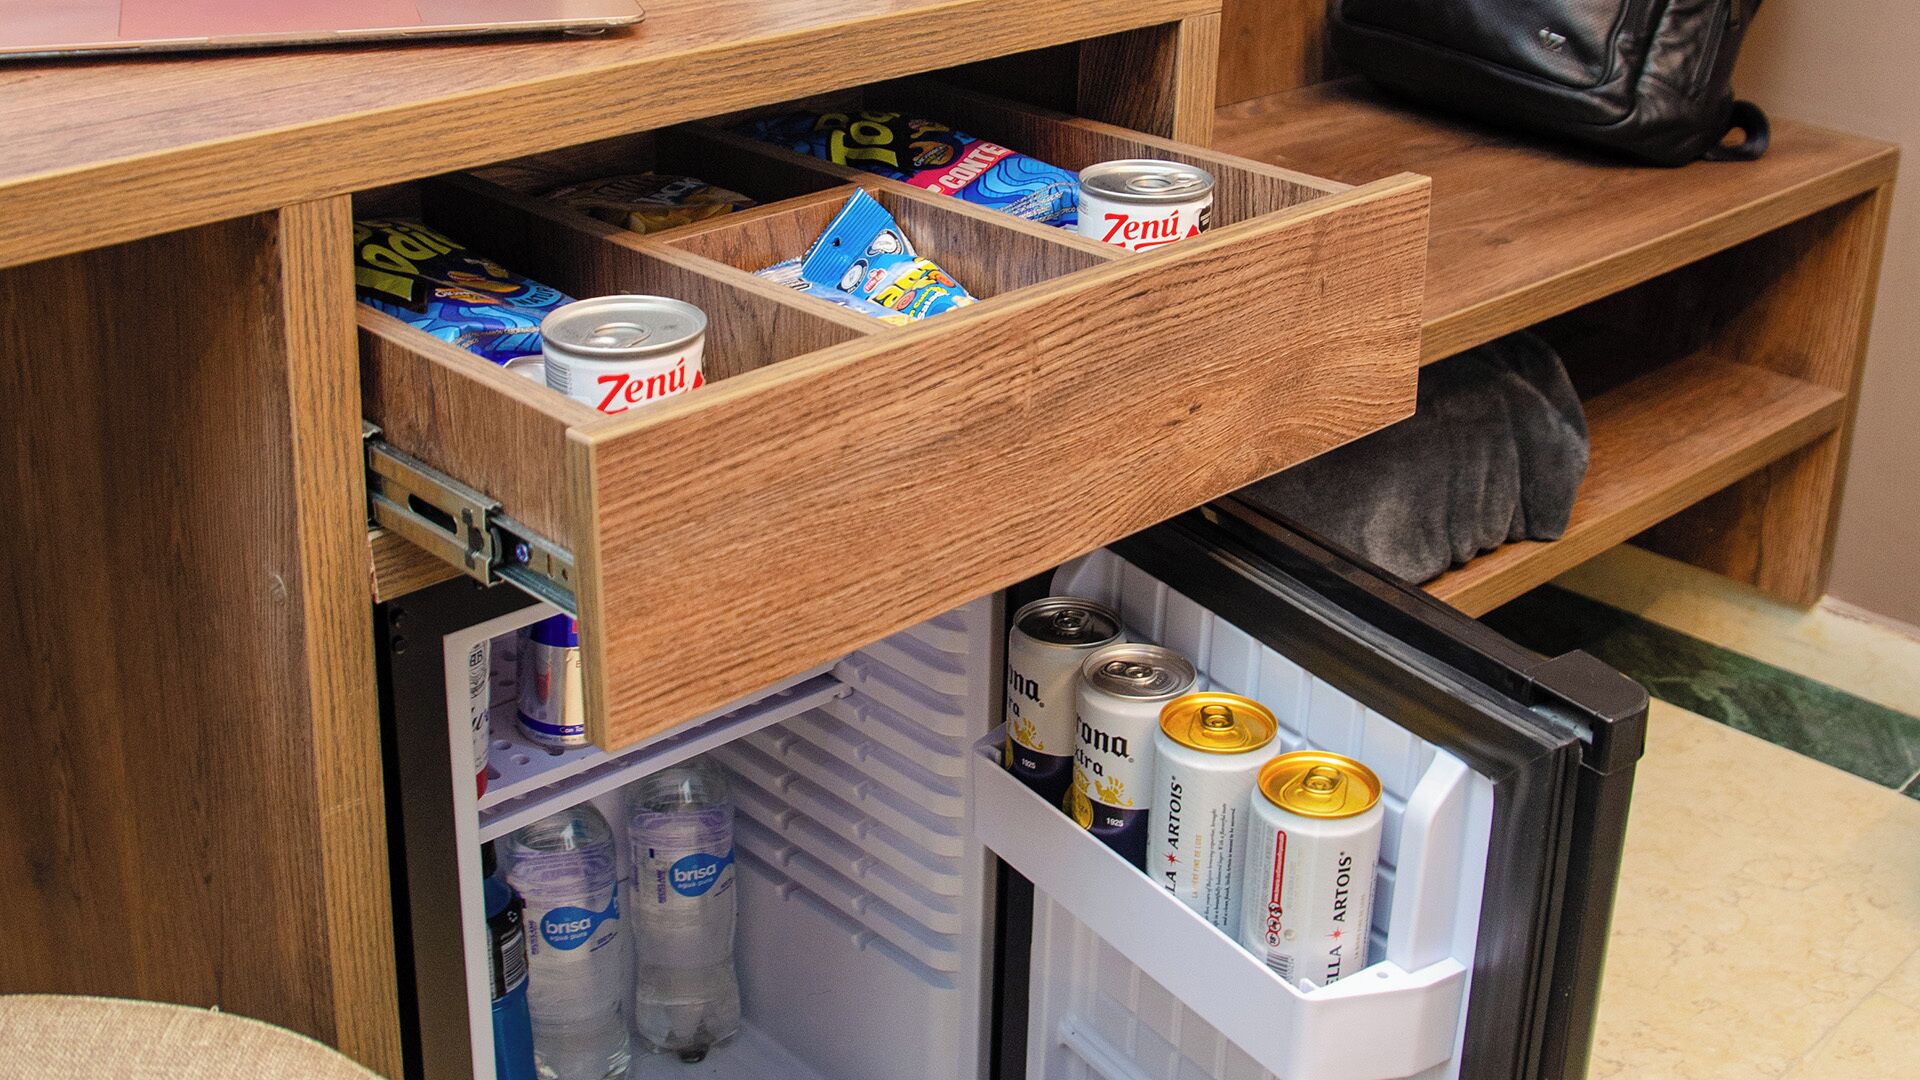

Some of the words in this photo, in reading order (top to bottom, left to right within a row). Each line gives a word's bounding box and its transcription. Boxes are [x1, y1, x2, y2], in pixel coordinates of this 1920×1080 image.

[1102, 209, 1179, 247] Zenú
[596, 357, 685, 415] Zenú
[1021, 757, 1037, 769] 1925
[1106, 817, 1124, 828] 1925
[1168, 780, 1183, 850] ARTOIS
[674, 862, 716, 883] brisa
[1333, 856, 1352, 922] ARTOIS
[545, 918, 591, 936] brisa
